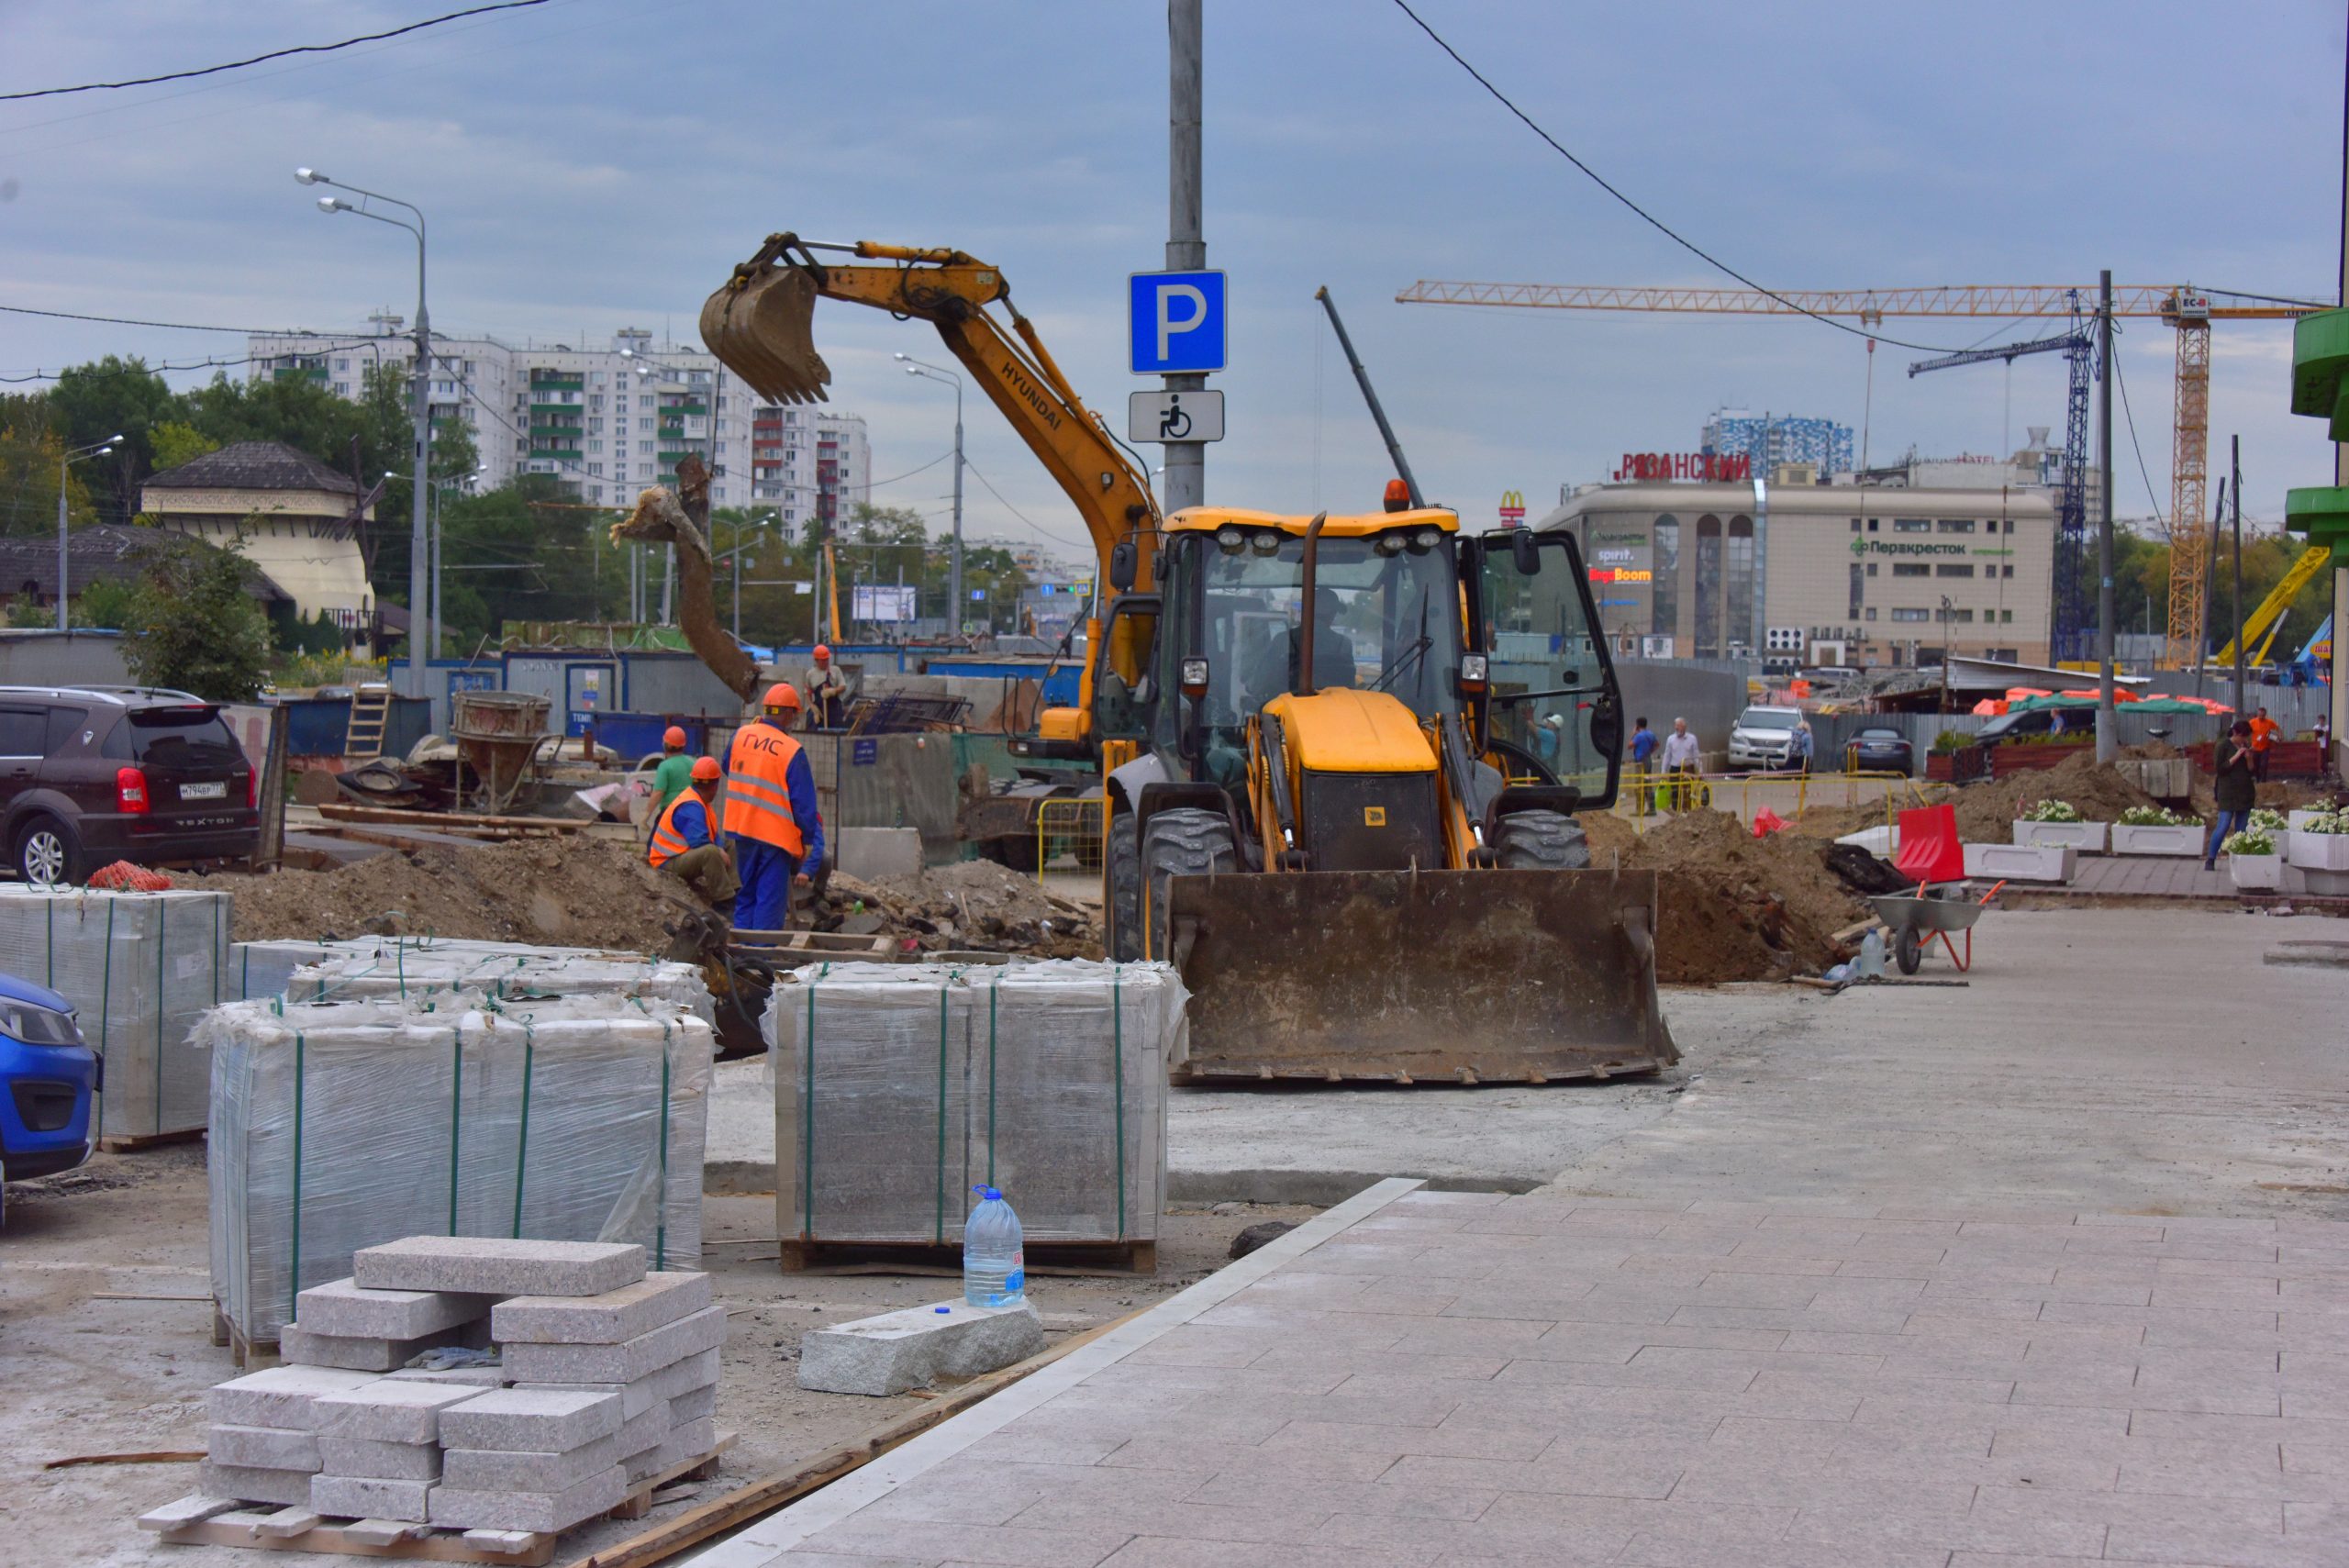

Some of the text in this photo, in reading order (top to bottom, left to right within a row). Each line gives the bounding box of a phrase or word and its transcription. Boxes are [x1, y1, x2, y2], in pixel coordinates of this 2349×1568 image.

[1156, 284, 1208, 361] P
[1002, 361, 1062, 431] HYUNDAI
[1622, 451, 1751, 480] РЯЗАНСКИЙ
[1870, 540, 1966, 557] Перекресток
